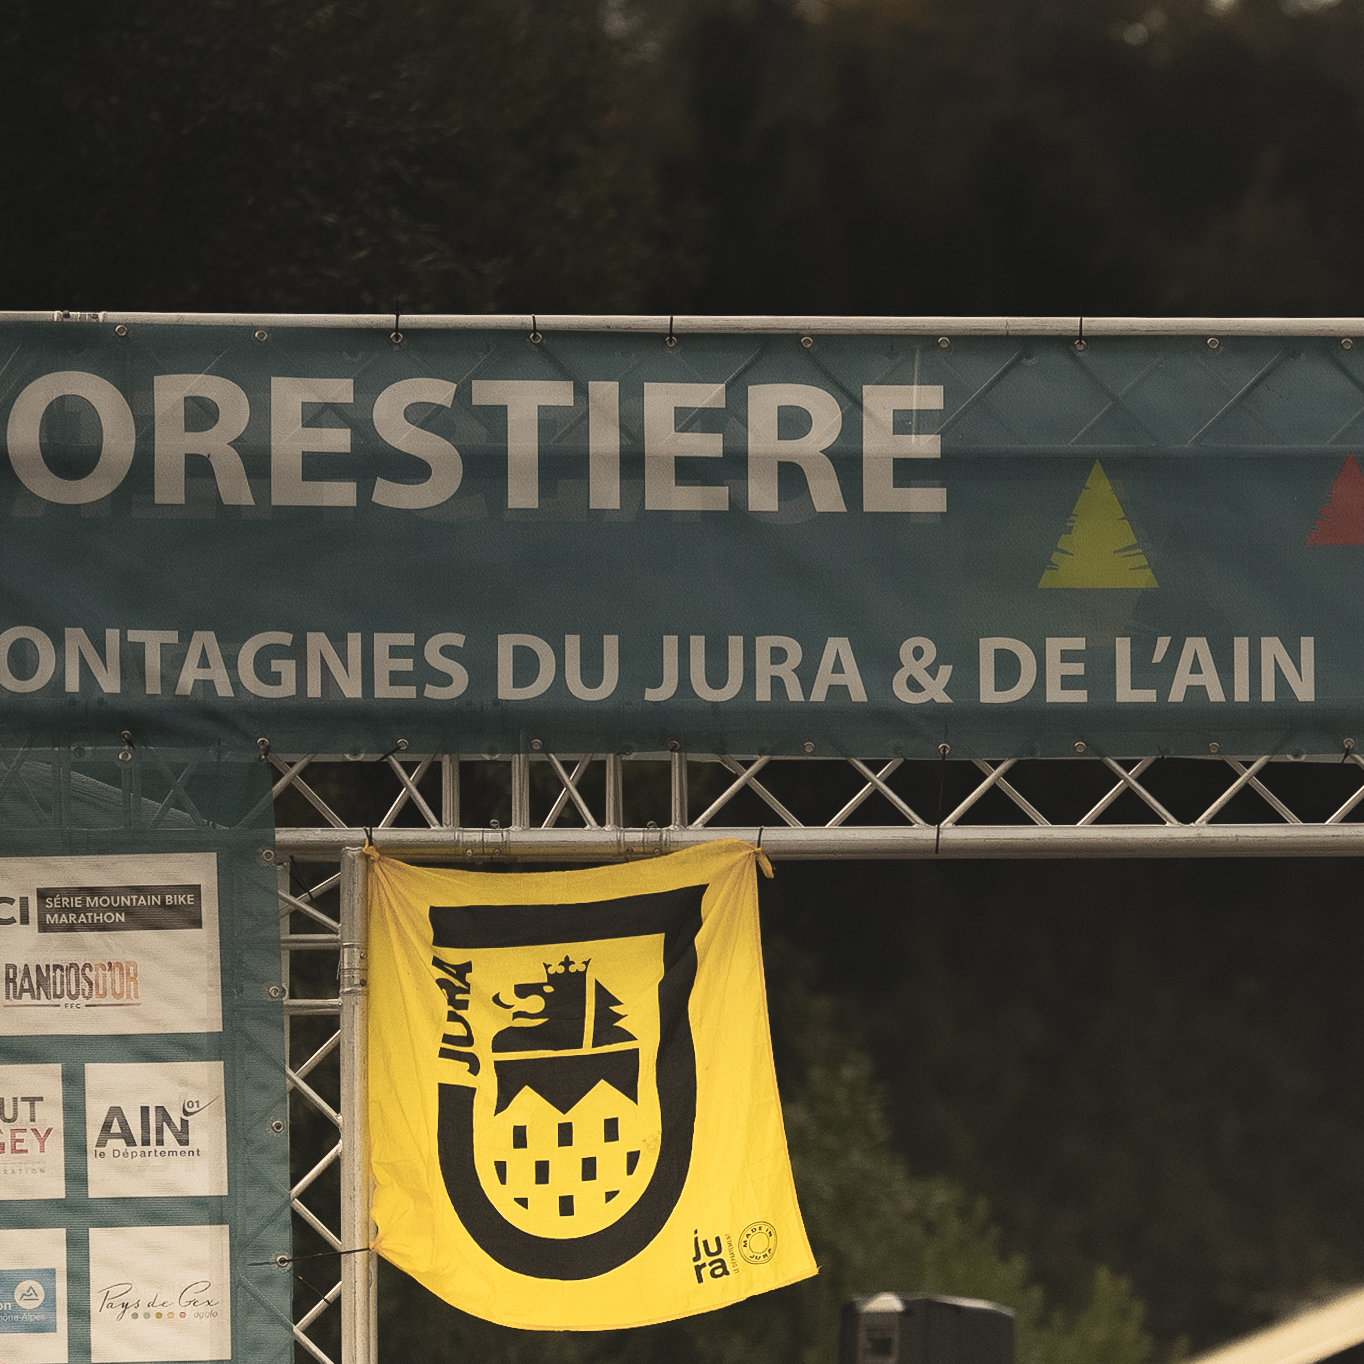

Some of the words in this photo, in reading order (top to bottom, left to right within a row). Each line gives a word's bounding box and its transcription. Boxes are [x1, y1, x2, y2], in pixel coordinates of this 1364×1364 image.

[7, 370, 948, 514] ORESTIERE
[0, 625, 468, 703] ONTAGNES
[498, 634, 620, 703] DU
[643, 633, 869, 705] JURA
[890, 635, 955, 706] &
[979, 635, 1088, 705] DE
[45, 894, 82, 909] SÉRIE
[86, 894, 162, 908] MOUNTAIN
[165, 893, 195, 906] BIKE
[46, 912, 125, 925] MARATHON
[0, 1127, 54, 1155] EY
[95, 1105, 190, 1148] AIN
[186, 1100, 200, 1109] 01
[95, 1149, 106, 1159] le
[112, 1147, 201, 1160] Département
[98, 1282, 141, 1322] Pays
[147, 1293, 175, 1309] de
